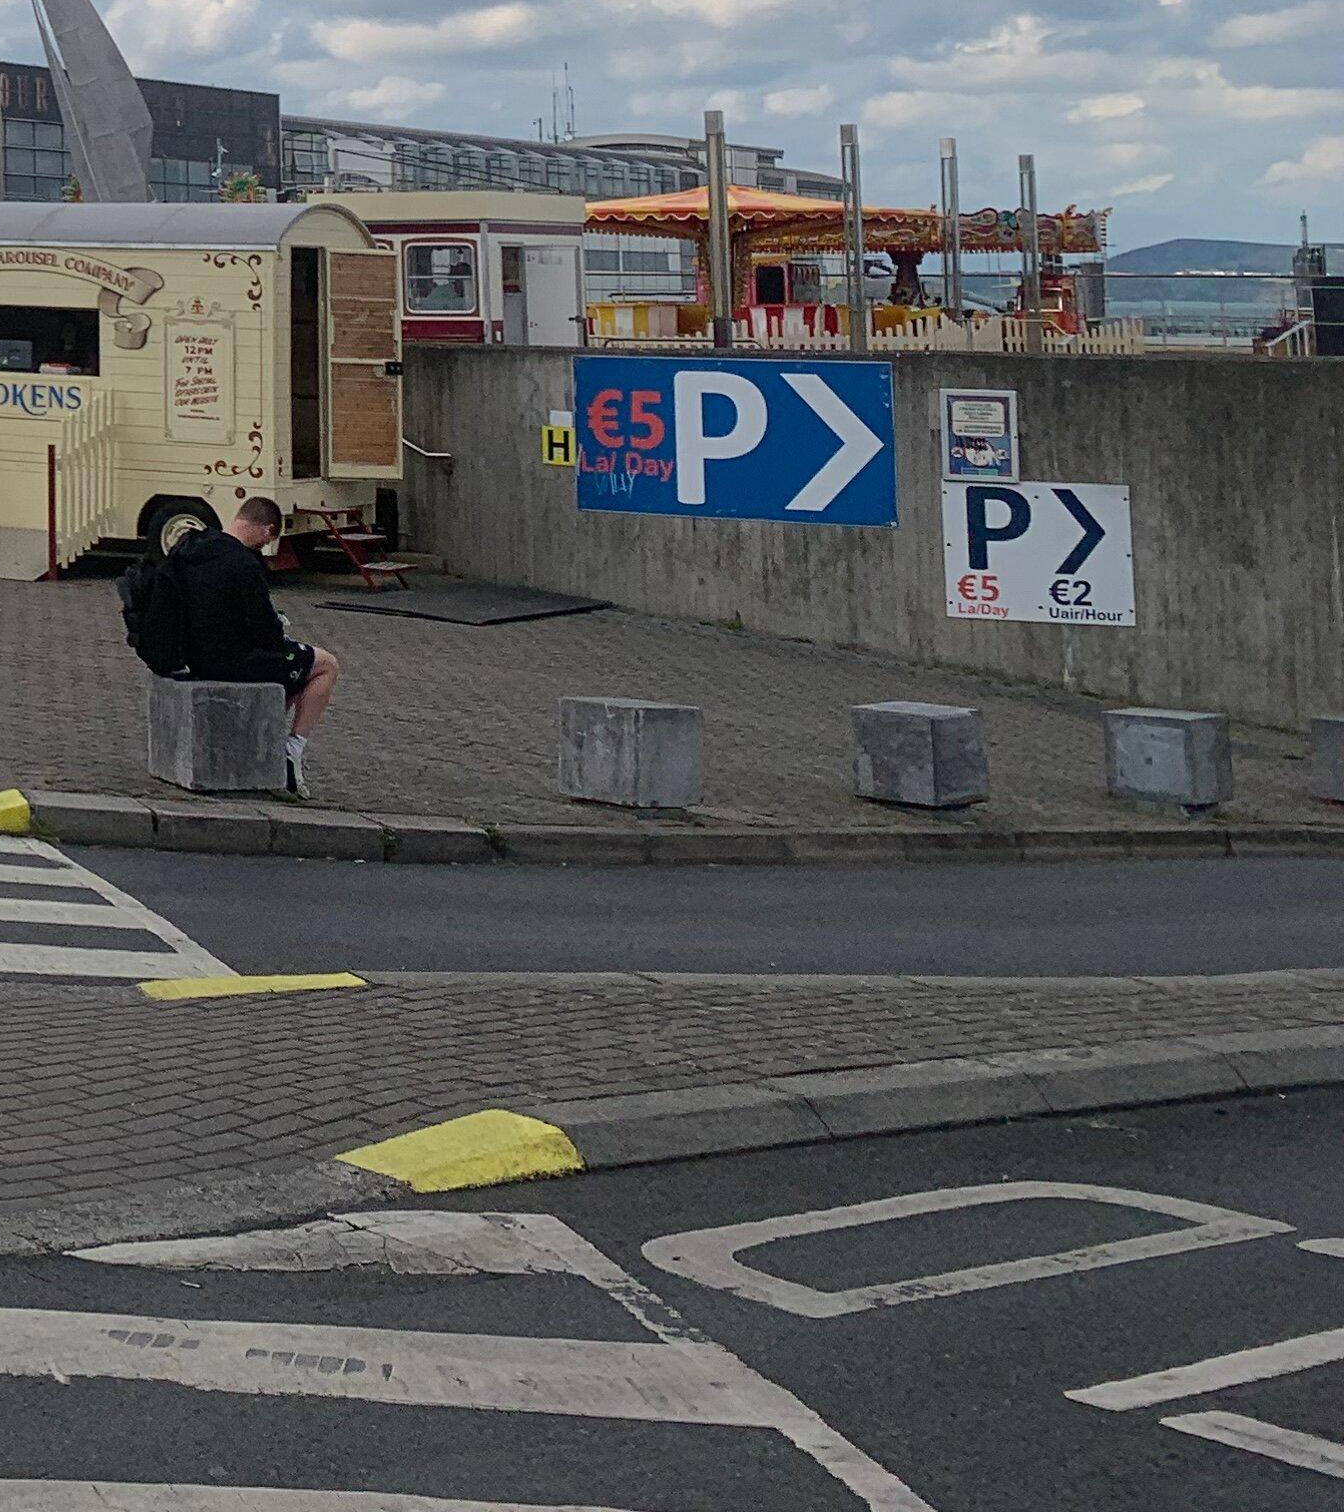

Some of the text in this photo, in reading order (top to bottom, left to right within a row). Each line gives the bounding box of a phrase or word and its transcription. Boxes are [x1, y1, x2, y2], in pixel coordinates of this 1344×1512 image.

[64, 257, 137, 292] COMPANY
[185, 366, 213, 376] 7 PM
[587, 388, 666, 449] €5
[547, 429, 570, 462] H
[673, 370, 768, 505] P
[625, 452, 675, 482] Day
[965, 485, 1032, 571] P
[956, 574, 1000, 602] €5
[1049, 579, 1093, 606] €2
[957, 603, 1010, 619] La/Day
[1049, 605, 1123, 622] Uair/Hour
